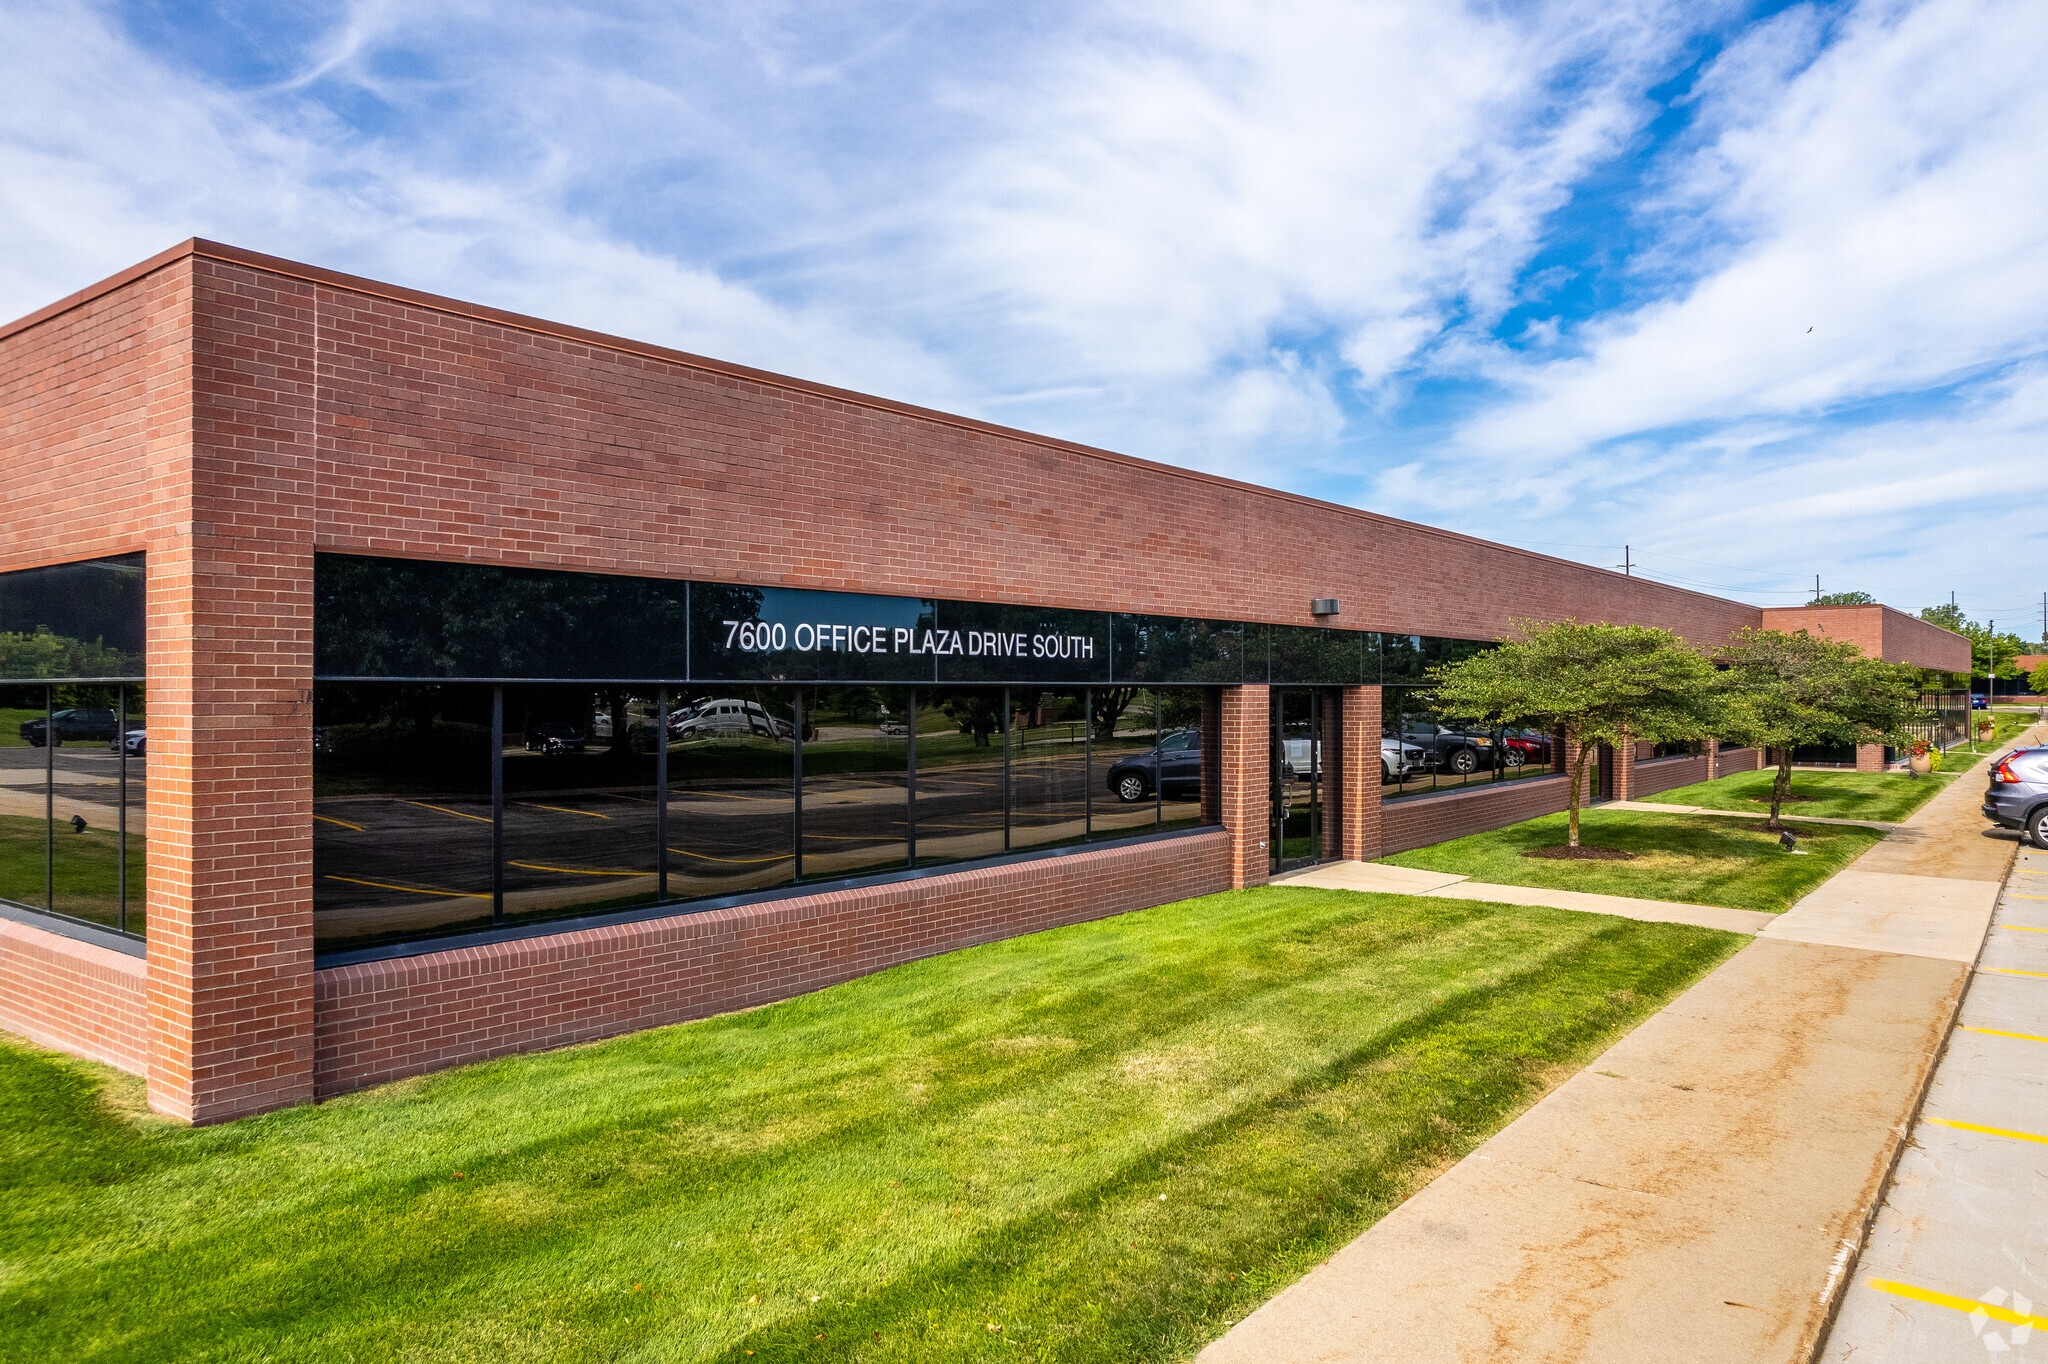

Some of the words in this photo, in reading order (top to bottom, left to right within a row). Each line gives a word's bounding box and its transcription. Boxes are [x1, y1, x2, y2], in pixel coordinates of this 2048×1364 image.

[722, 620, 787, 652] 7600
[794, 623, 887, 653] OFFICE
[894, 628, 964, 655] PLAZA
[968, 631, 1028, 657] DRIVE
[1032, 634, 1094, 660] SOUTH
